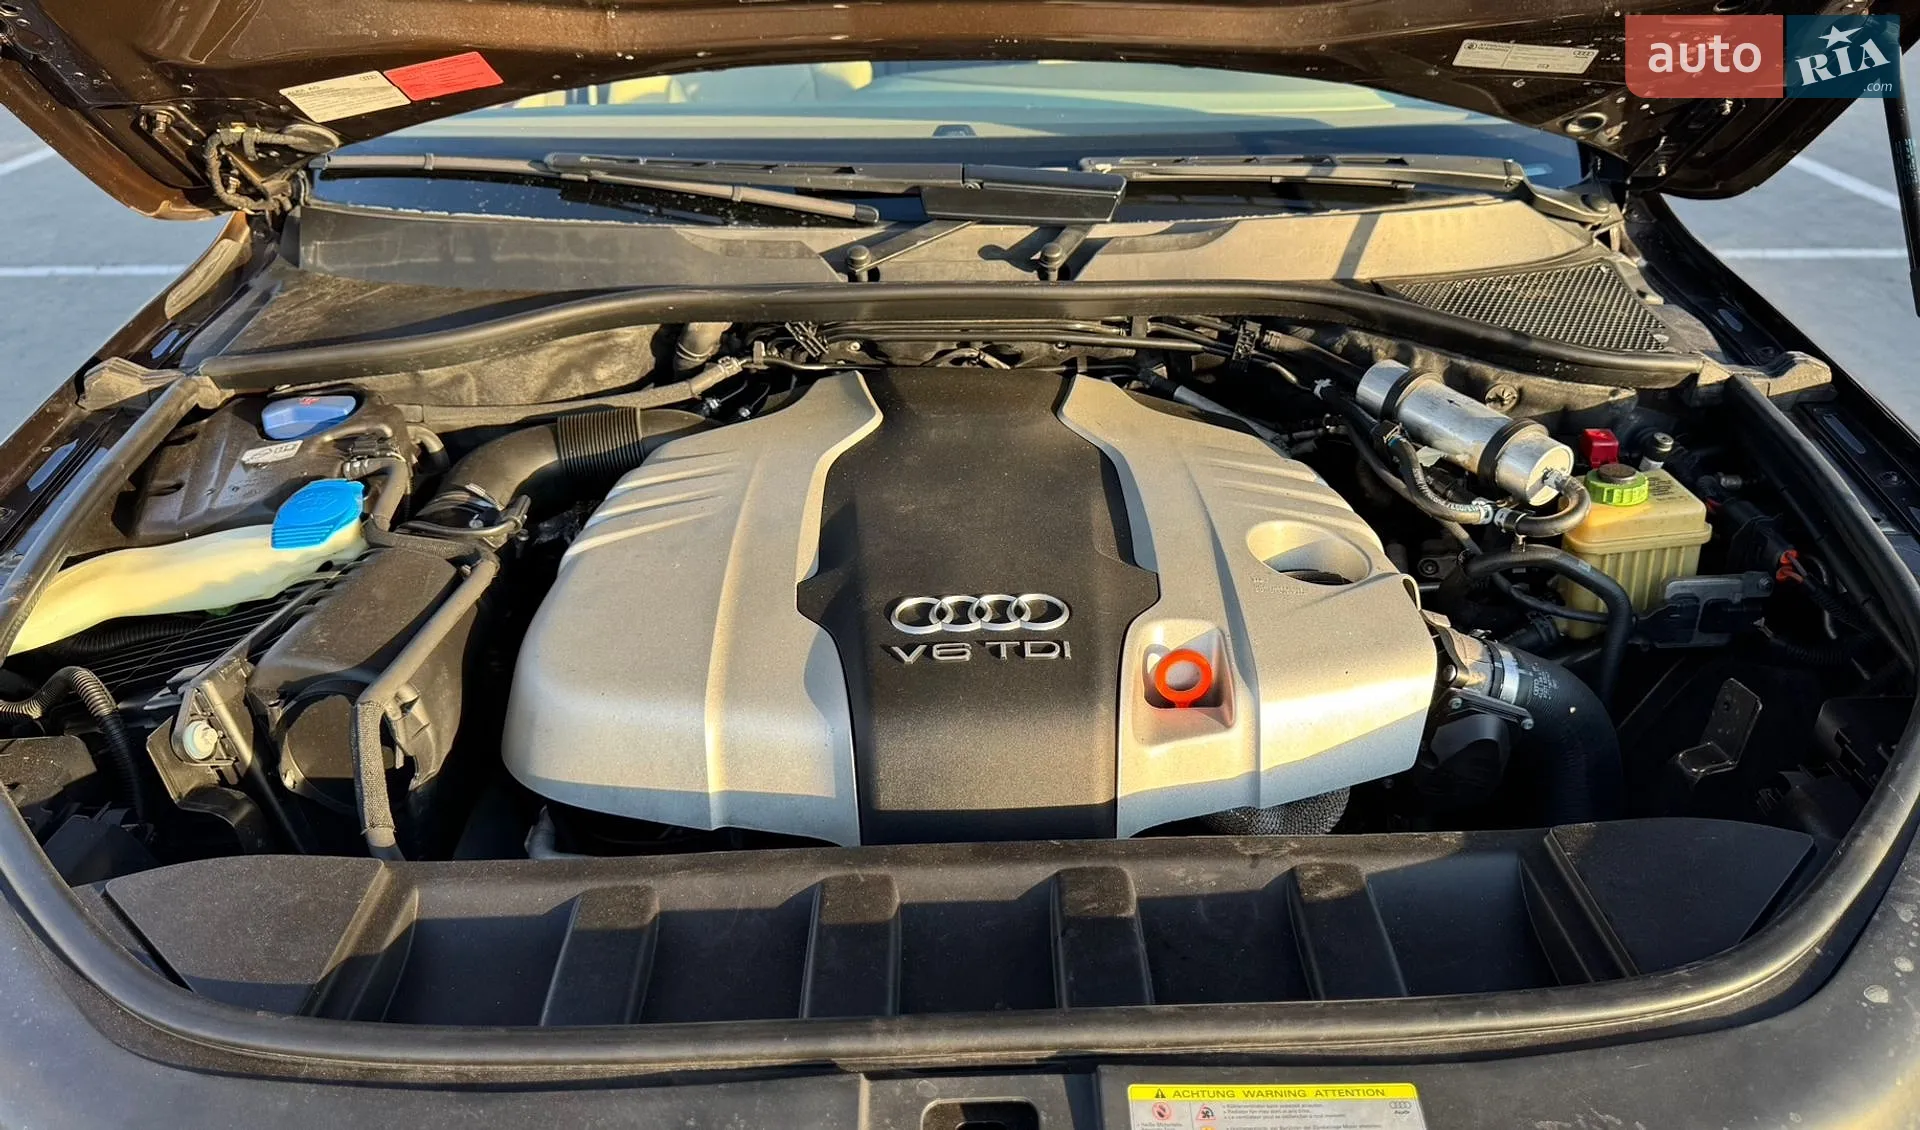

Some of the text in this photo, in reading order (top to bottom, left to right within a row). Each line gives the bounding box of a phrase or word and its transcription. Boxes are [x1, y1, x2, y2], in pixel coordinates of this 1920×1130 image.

[890, 640, 1072, 665] V6 TDI
[1172, 1087, 1386, 1099] ACHTUNG WARNING ATTENTION
